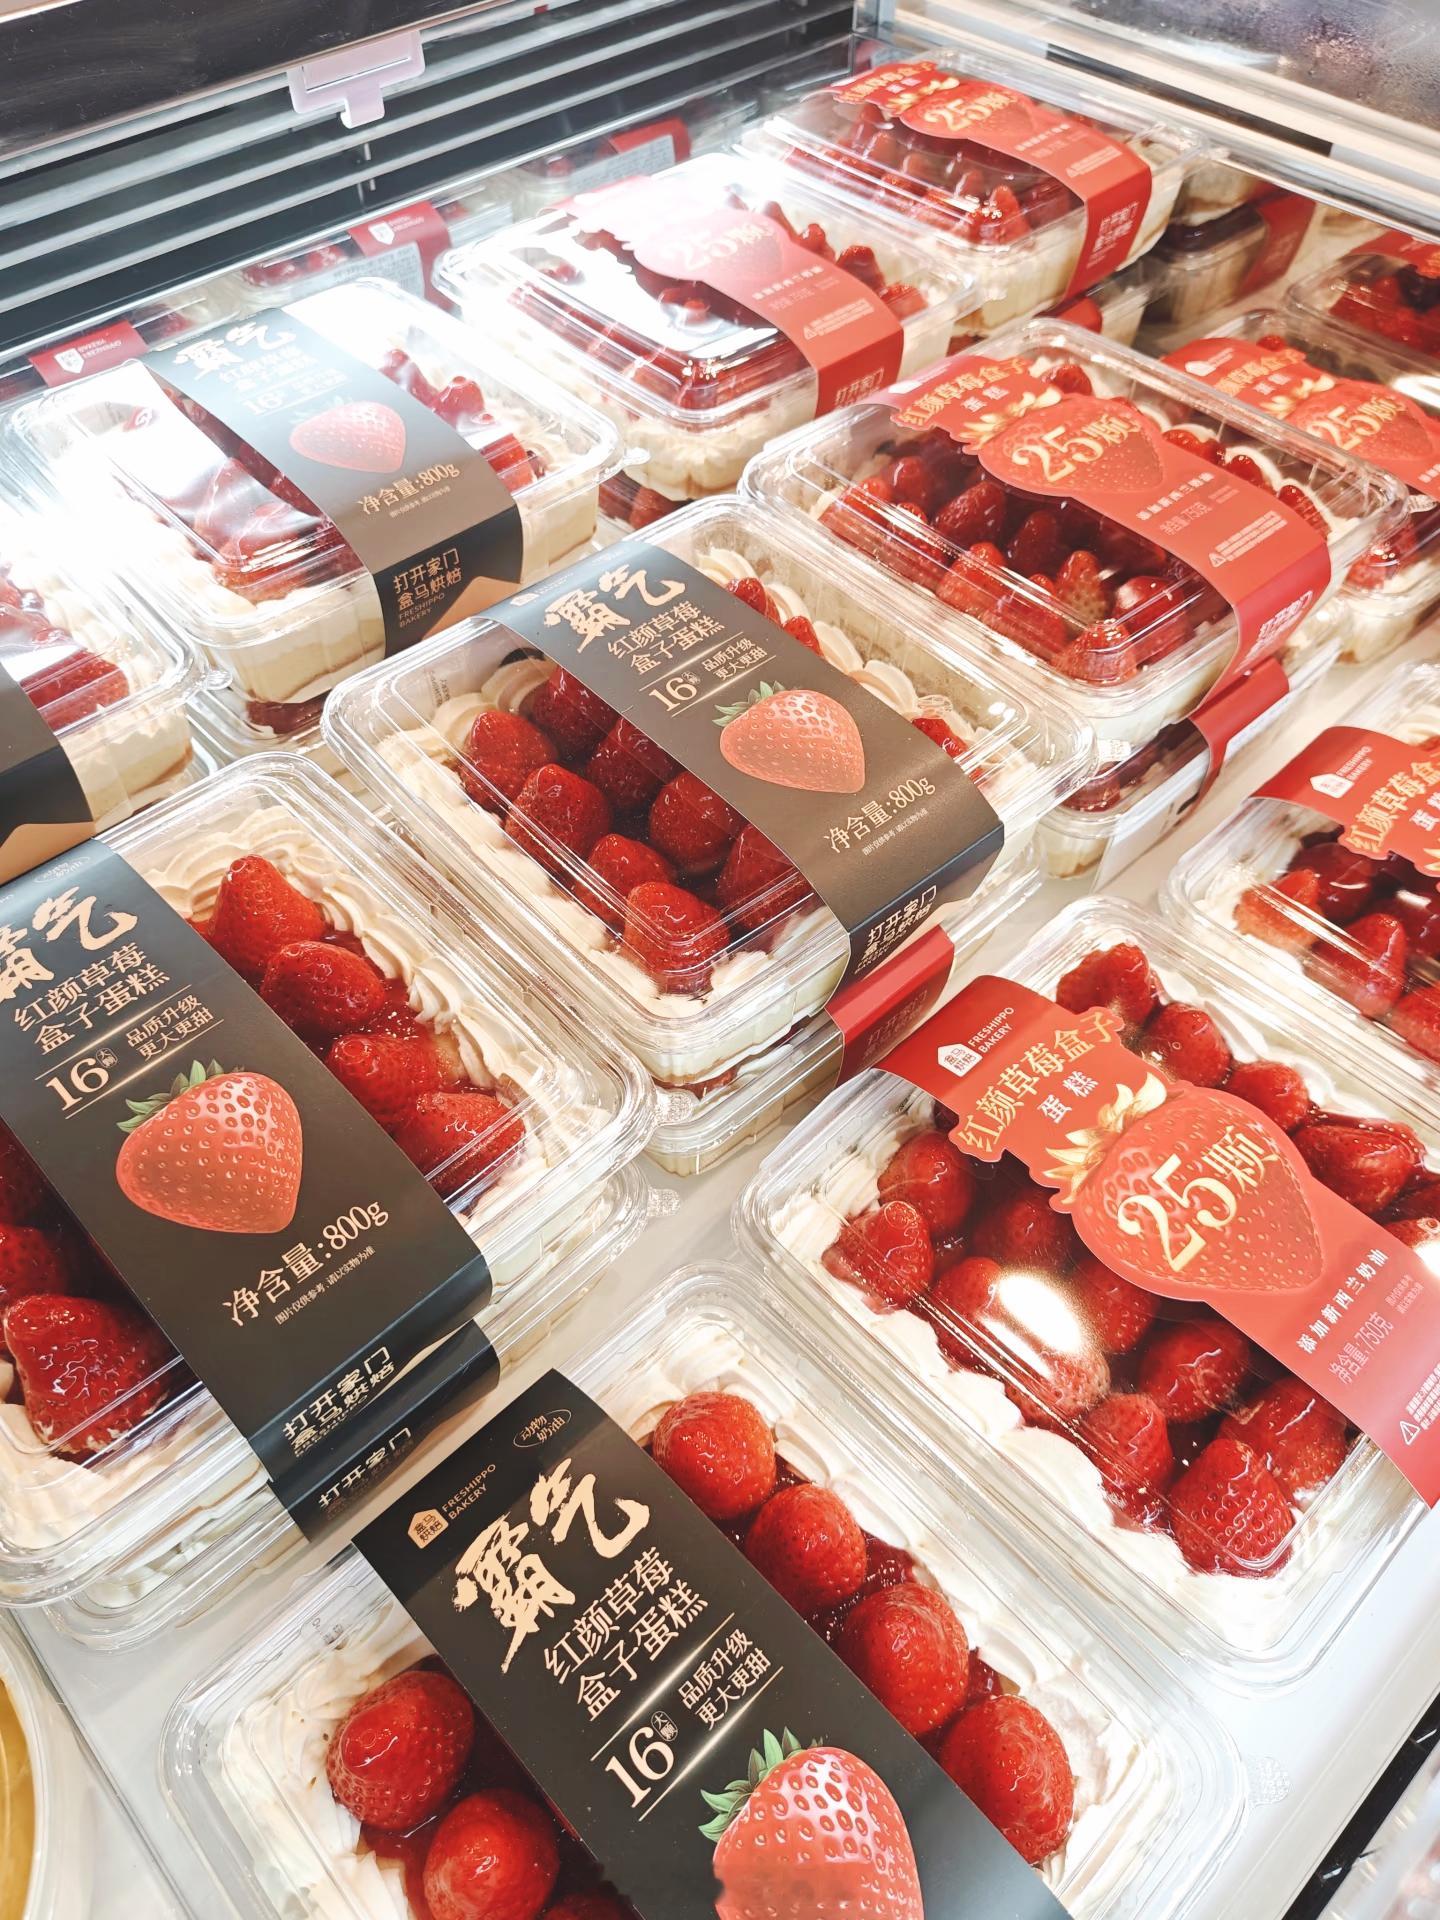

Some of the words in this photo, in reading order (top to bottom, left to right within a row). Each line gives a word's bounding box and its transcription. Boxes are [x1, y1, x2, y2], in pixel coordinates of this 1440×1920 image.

[1012, 414, 1141, 482] 25颗
[358, 463, 461, 515] 净含量:800g
[393, 548, 461, 594] 打开家门
[398, 567, 462, 611] 盒马烘焙
[399, 592, 446, 620] FRESHIPPO
[544, 564, 686, 654] 霸气
[607, 601, 702, 659] 红颜草莓
[630, 615, 725, 675] 盒子蛋糕
[702, 638, 756, 672] 品质升级
[713, 647, 768, 681] 更大更甜
[649, 677, 697, 712] 16
[824, 778, 936, 854] 净含量:800g
[862, 903, 933, 961] 盒马烘焙
[867, 885, 937, 947] 打开家门
[14, 942, 147, 1032] 红颜草莓
[35, 963, 170, 1055] 盒子蛋糕
[126, 995, 202, 1048] 品质升级
[136, 1008, 214, 1061] 更大更甜
[968, 1007, 1014, 1047] FRESHIPPO
[978, 1023, 1012, 1053] BAKERY
[45, 1057, 110, 1111] 16
[958, 1011, 1117, 1153] 红颜草莓盒子
[1037, 1071, 1099, 1124] 蛋糕
[1118, 1125, 1279, 1273] 25颗
[222, 1202, 389, 1326] 净含量:800g
[1296, 1248, 1390, 1355] 添加新西兰奶油
[283, 1346, 391, 1440] 打开家门
[291, 1361, 395, 1451] 盒马烘焙
[522, 1415, 548, 1441] 动物
[536, 1416, 566, 1442] 奶油
[319, 1428, 411, 1508] 打开家门
[441, 1463, 497, 1513] FRESHIPPO
[448, 1483, 488, 1520] BAKERY
[452, 1458, 650, 1674] 霸气
[544, 1546, 674, 1684] 红颜草莓
[577, 1579, 708, 1722] 盒子蛋糕
[678, 1628, 753, 1709] 品质升级
[695, 1647, 772, 1731] 更大更甜
[605, 1726, 675, 1808] 16
